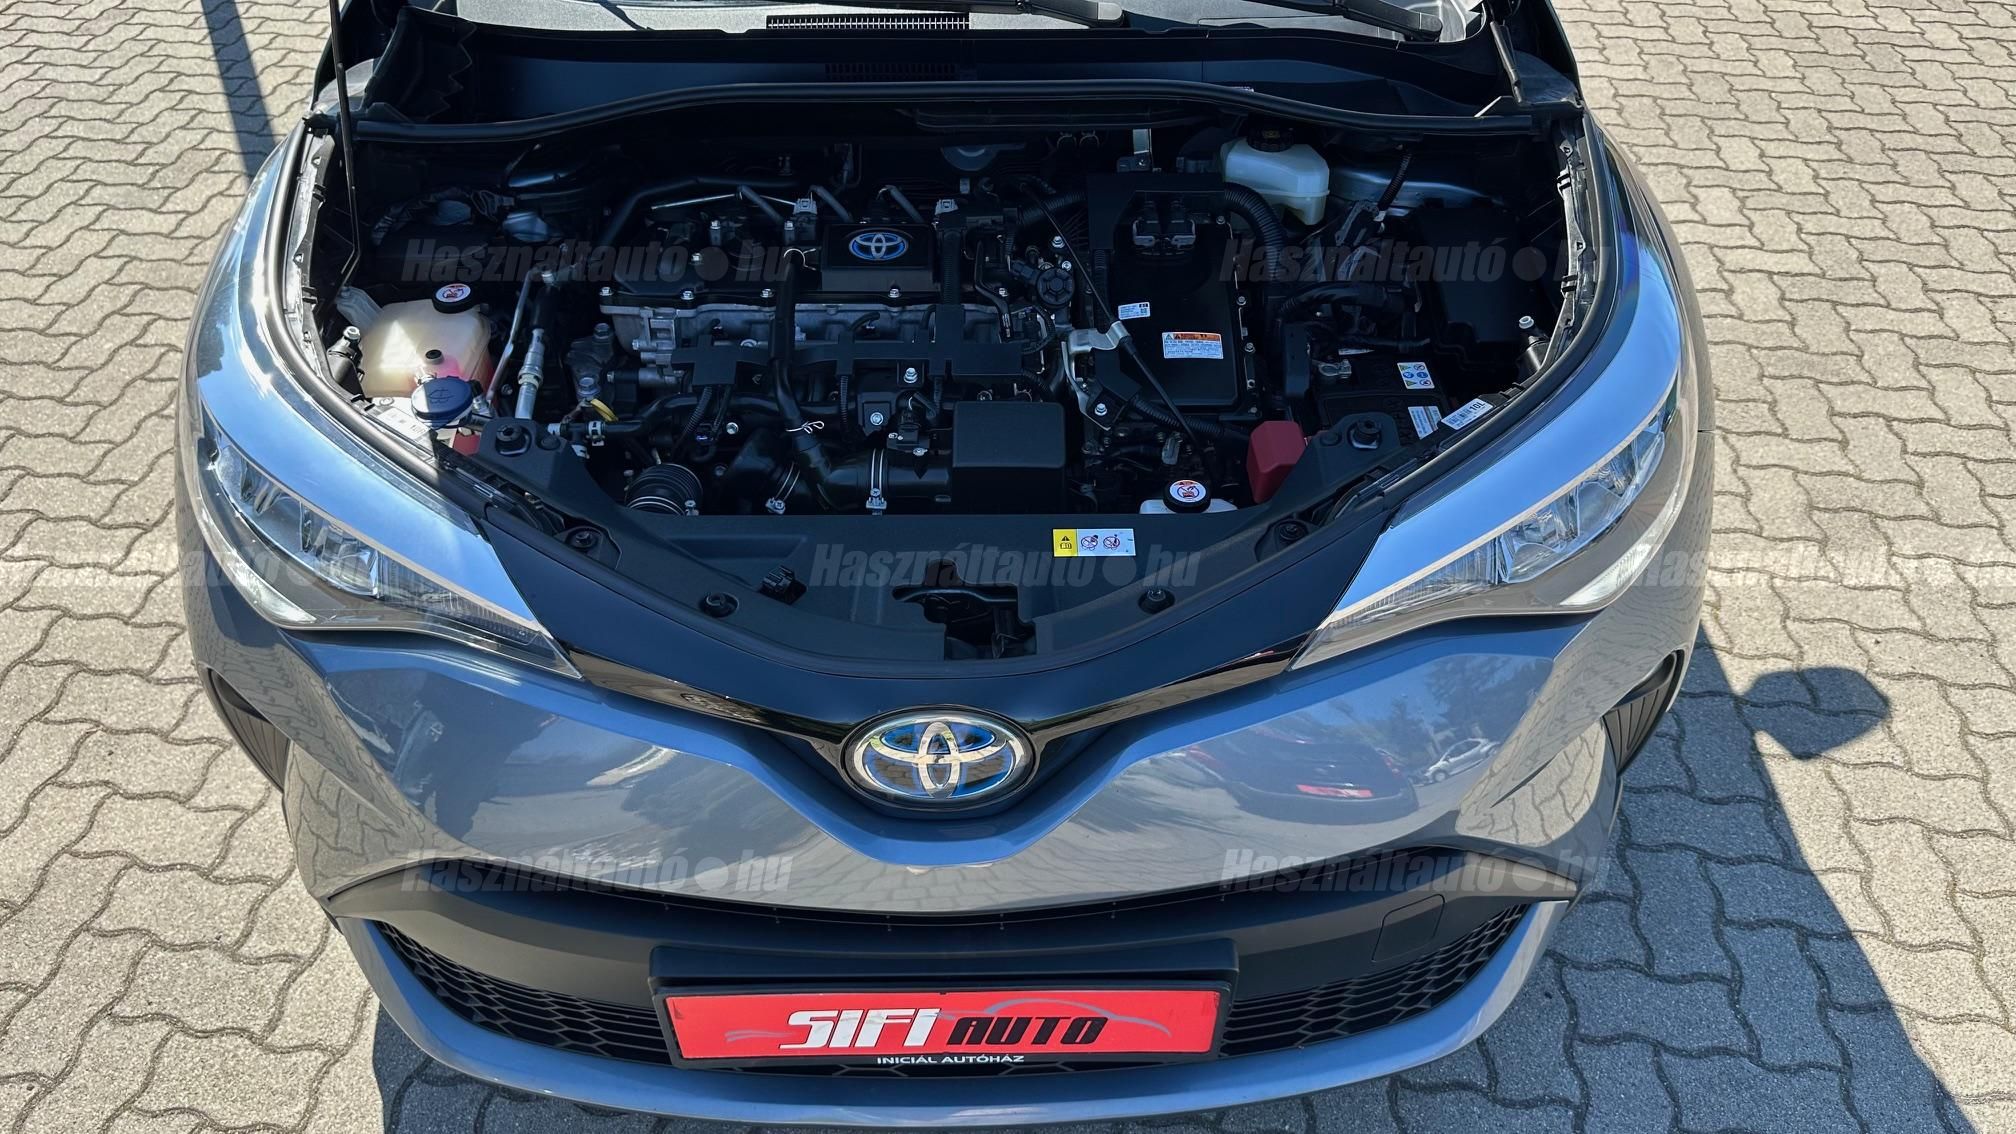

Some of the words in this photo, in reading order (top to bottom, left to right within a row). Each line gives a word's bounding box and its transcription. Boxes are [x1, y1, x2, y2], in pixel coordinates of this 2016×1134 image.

[778, 1007, 941, 1049] SIFI
[947, 1016, 1109, 1046] AUTO
[877, 1055, 937, 1064] INICIÁL
[941, 1054, 1025, 1064] AUTÓHÁZ
